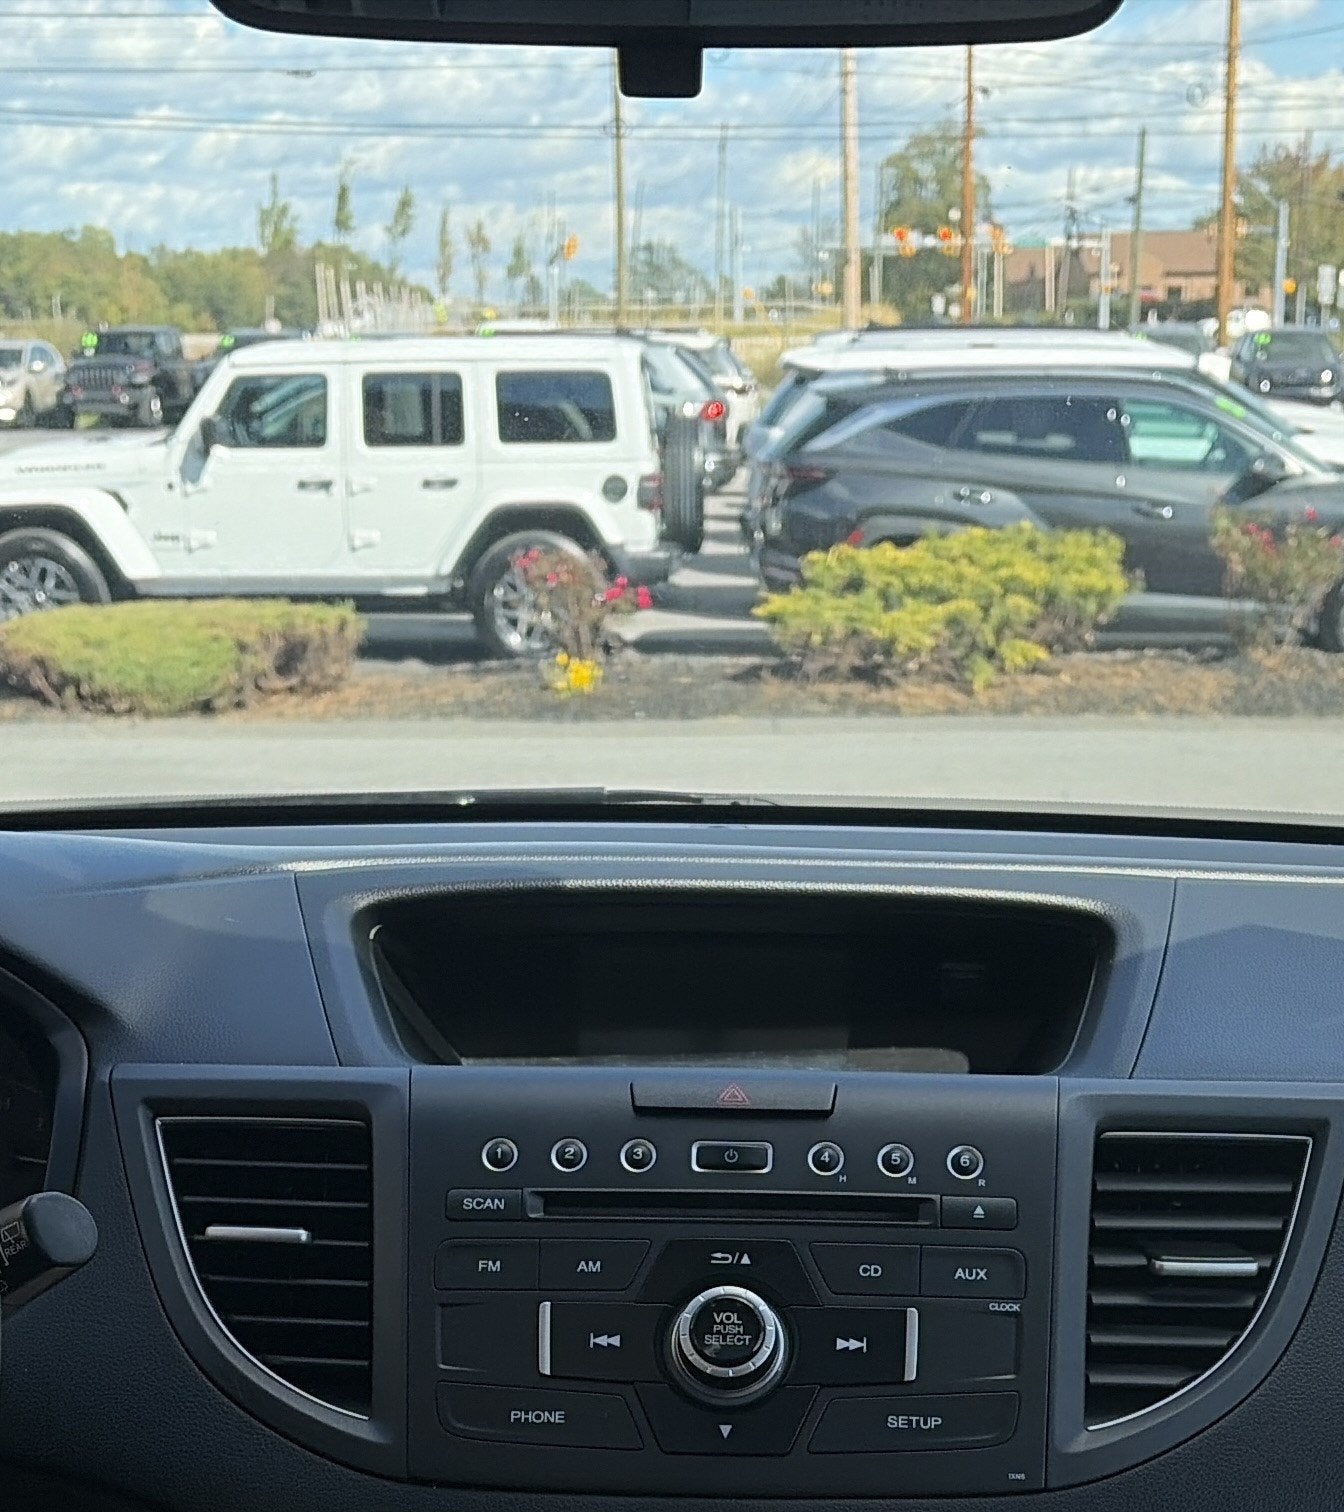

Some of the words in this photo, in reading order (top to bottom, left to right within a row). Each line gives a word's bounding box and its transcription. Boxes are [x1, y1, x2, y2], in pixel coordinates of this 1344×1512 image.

[495, 1147, 504, 1159] 1
[564, 1147, 575, 1160] 2
[632, 1148, 643, 1160] 3
[820, 1151, 831, 1163] 4
[890, 1153, 902, 1165] 5
[959, 1155, 971, 1167] 6
[838, 1174, 848, 1183] H
[907, 1176, 918, 1185] M
[978, 1178, 987, 1188] R
[462, 1197, 505, 1211] SCAN
[4, 1240, 28, 1257] REAR
[478, 1260, 501, 1272] FM
[576, 1260, 601, 1273] AM
[858, 1264, 882, 1278] CD
[954, 1268, 988, 1281] AUX
[988, 1302, 1021, 1313] CLOCK
[712, 1311, 743, 1324] VOL
[712, 1324, 744, 1335] PUSH
[704, 1334, 752, 1346] SELECT
[510, 1410, 566, 1424] PHONE
[887, 1415, 943, 1430] SETUP
